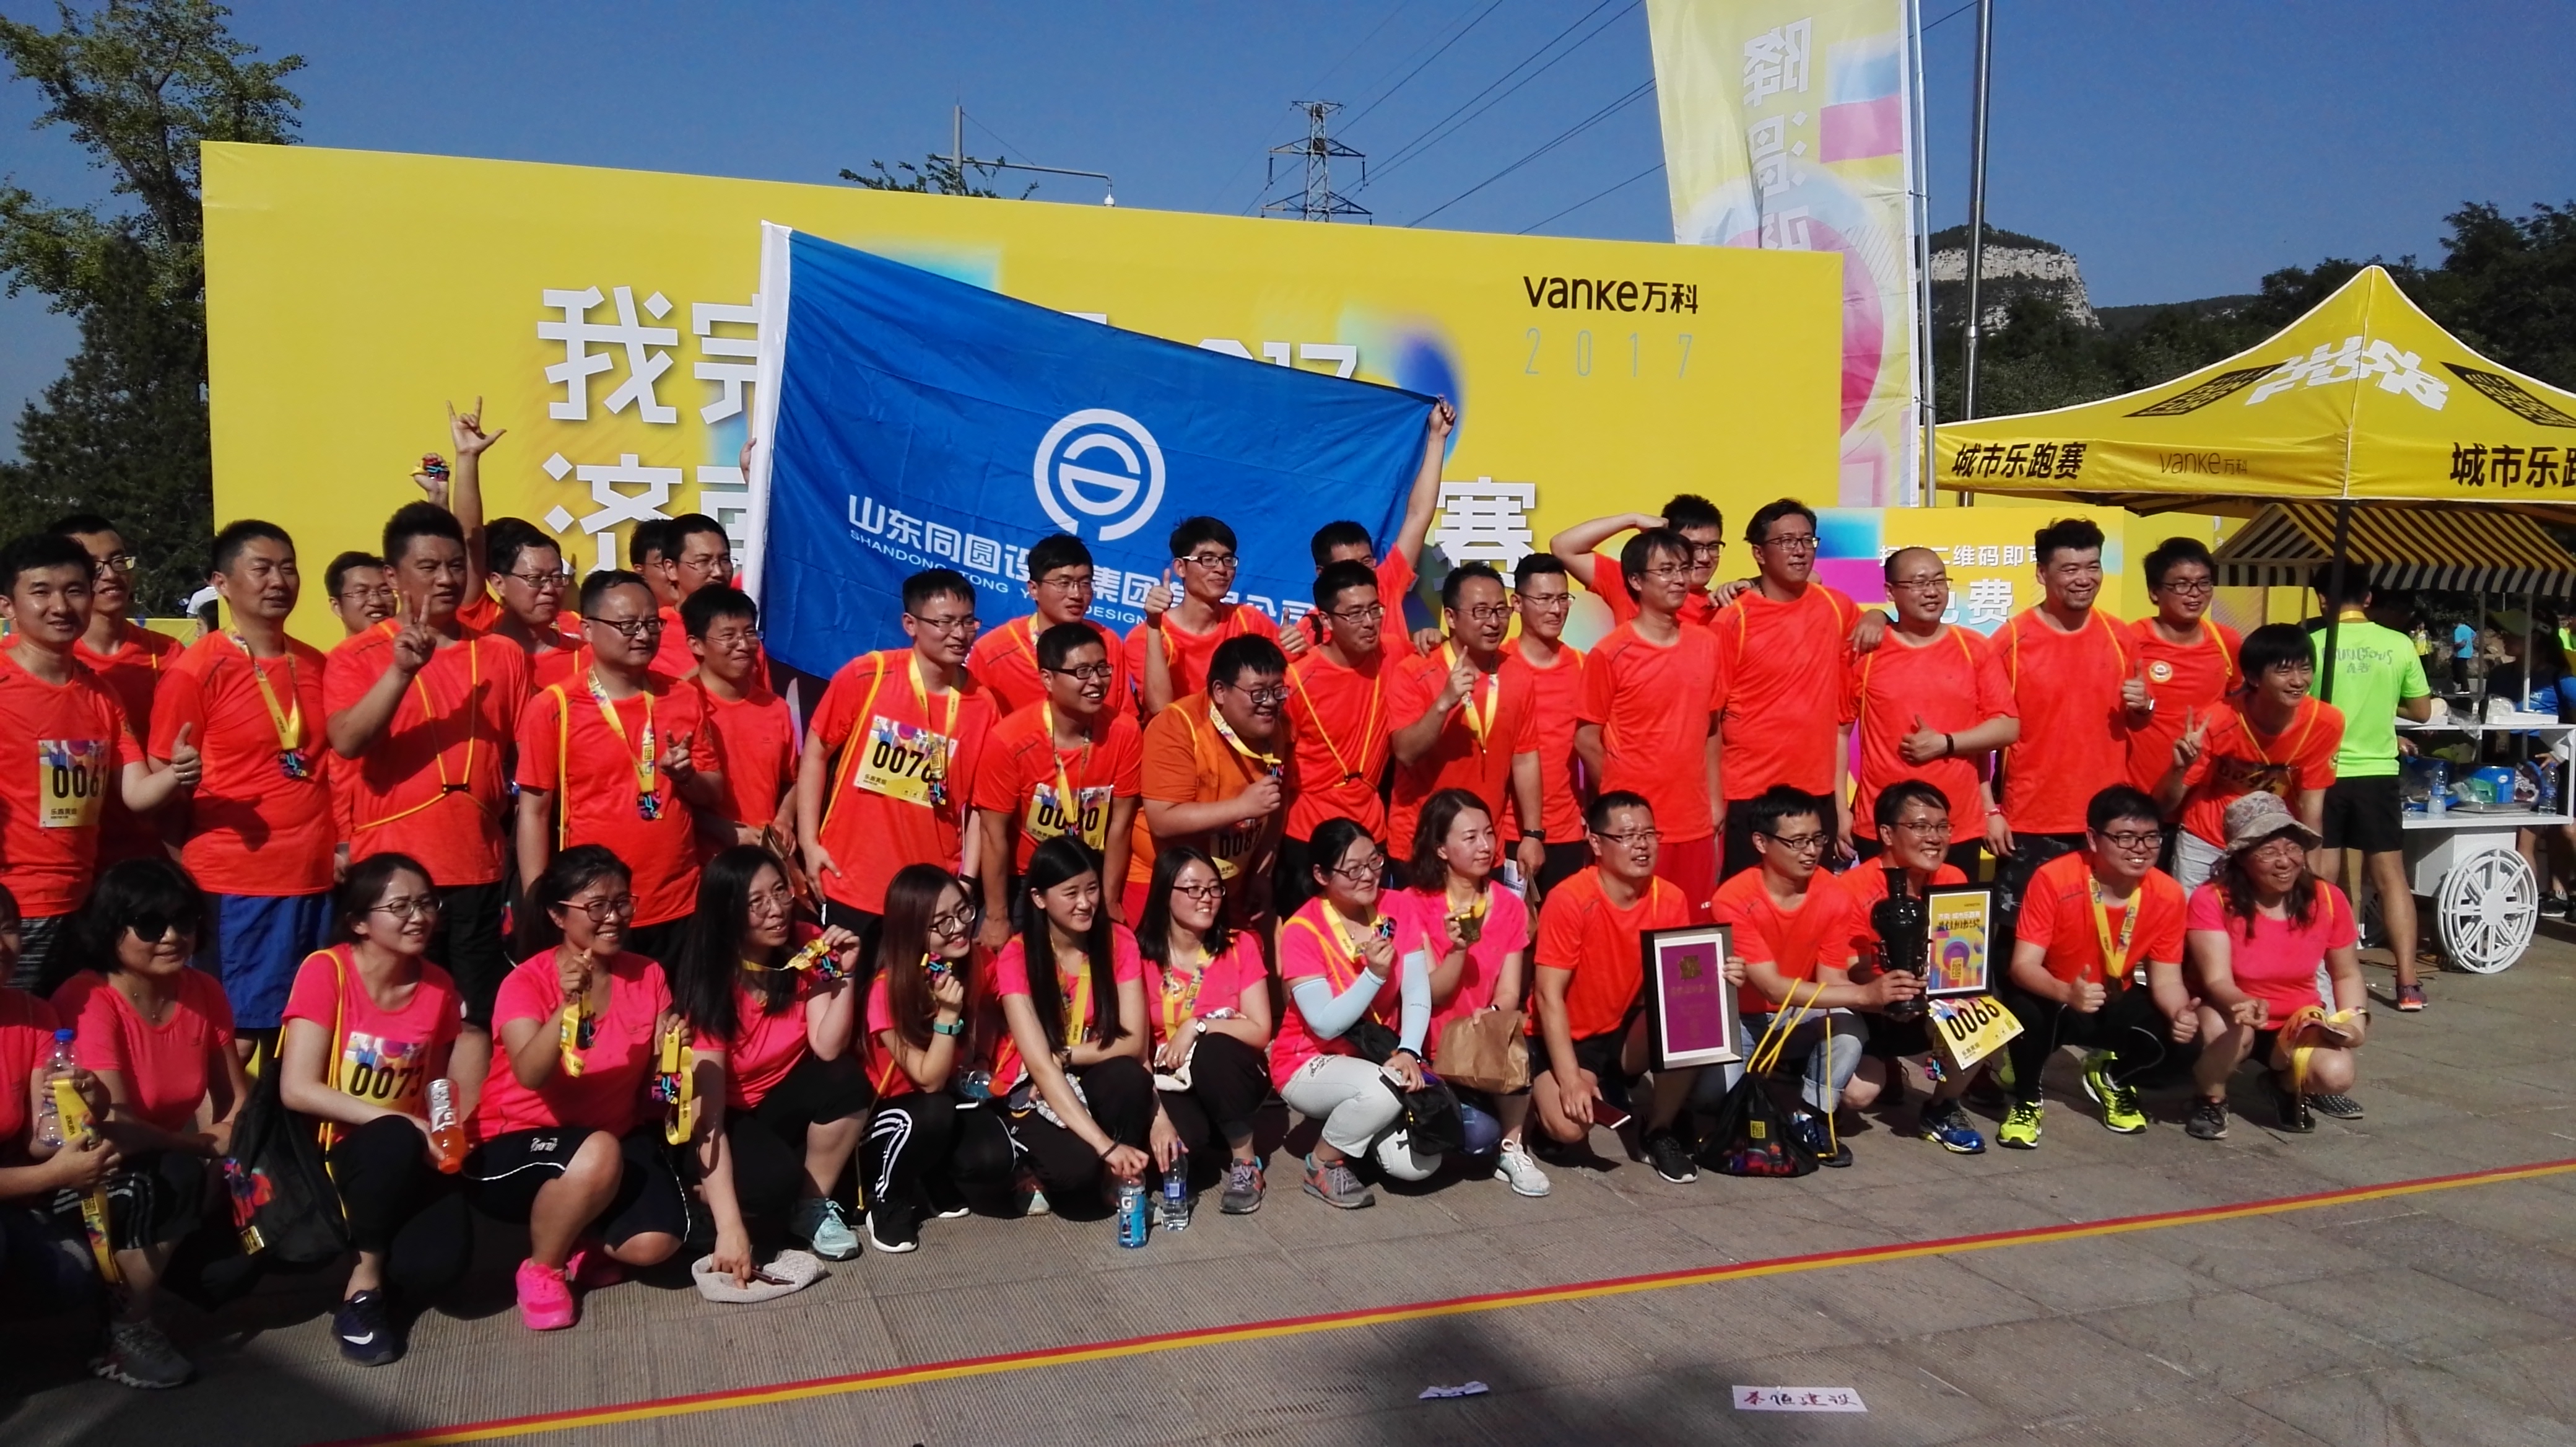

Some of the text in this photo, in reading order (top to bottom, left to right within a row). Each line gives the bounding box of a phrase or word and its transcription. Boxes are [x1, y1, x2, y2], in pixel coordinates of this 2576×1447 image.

[1951, 442, 2087, 479] 城市乐跑赛
[1946, 998, 2000, 1041] 0066
